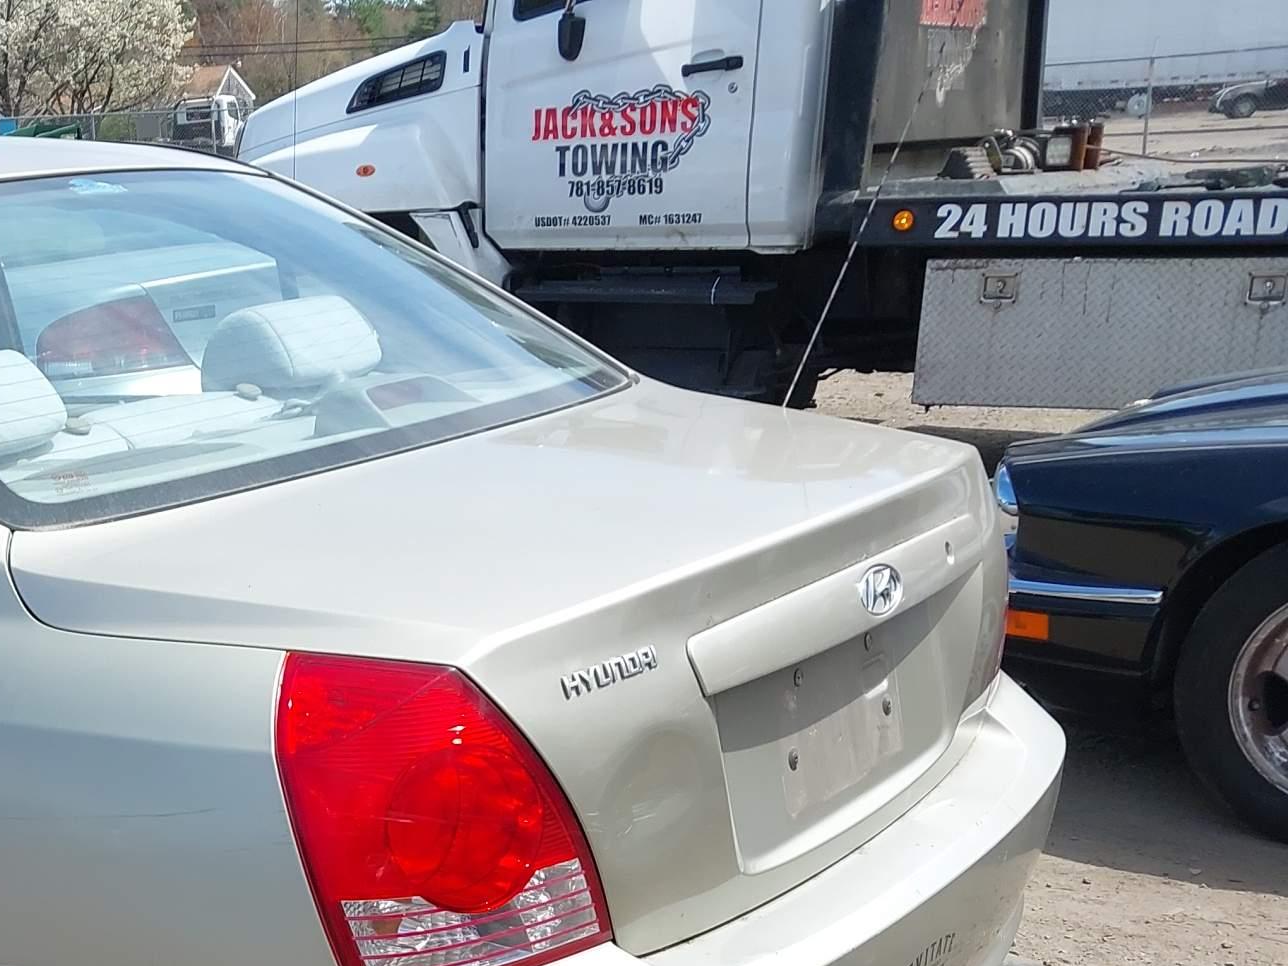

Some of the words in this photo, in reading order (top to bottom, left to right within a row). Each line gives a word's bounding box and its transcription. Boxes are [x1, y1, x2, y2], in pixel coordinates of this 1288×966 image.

[531, 95, 701, 141] JACK&SONS
[555, 139, 670, 178] TOWING
[567, 177, 665, 198] 781-857-8619
[534, 215, 570, 228] USDOT#
[571, 214, 612, 227] 4220537
[638, 213, 661, 226] MC#
[662, 212, 703, 225] 1631247
[933, 203, 988, 239] 24
[996, 200, 1150, 238] HOURS
[1158, 198, 1288, 237] ROAD
